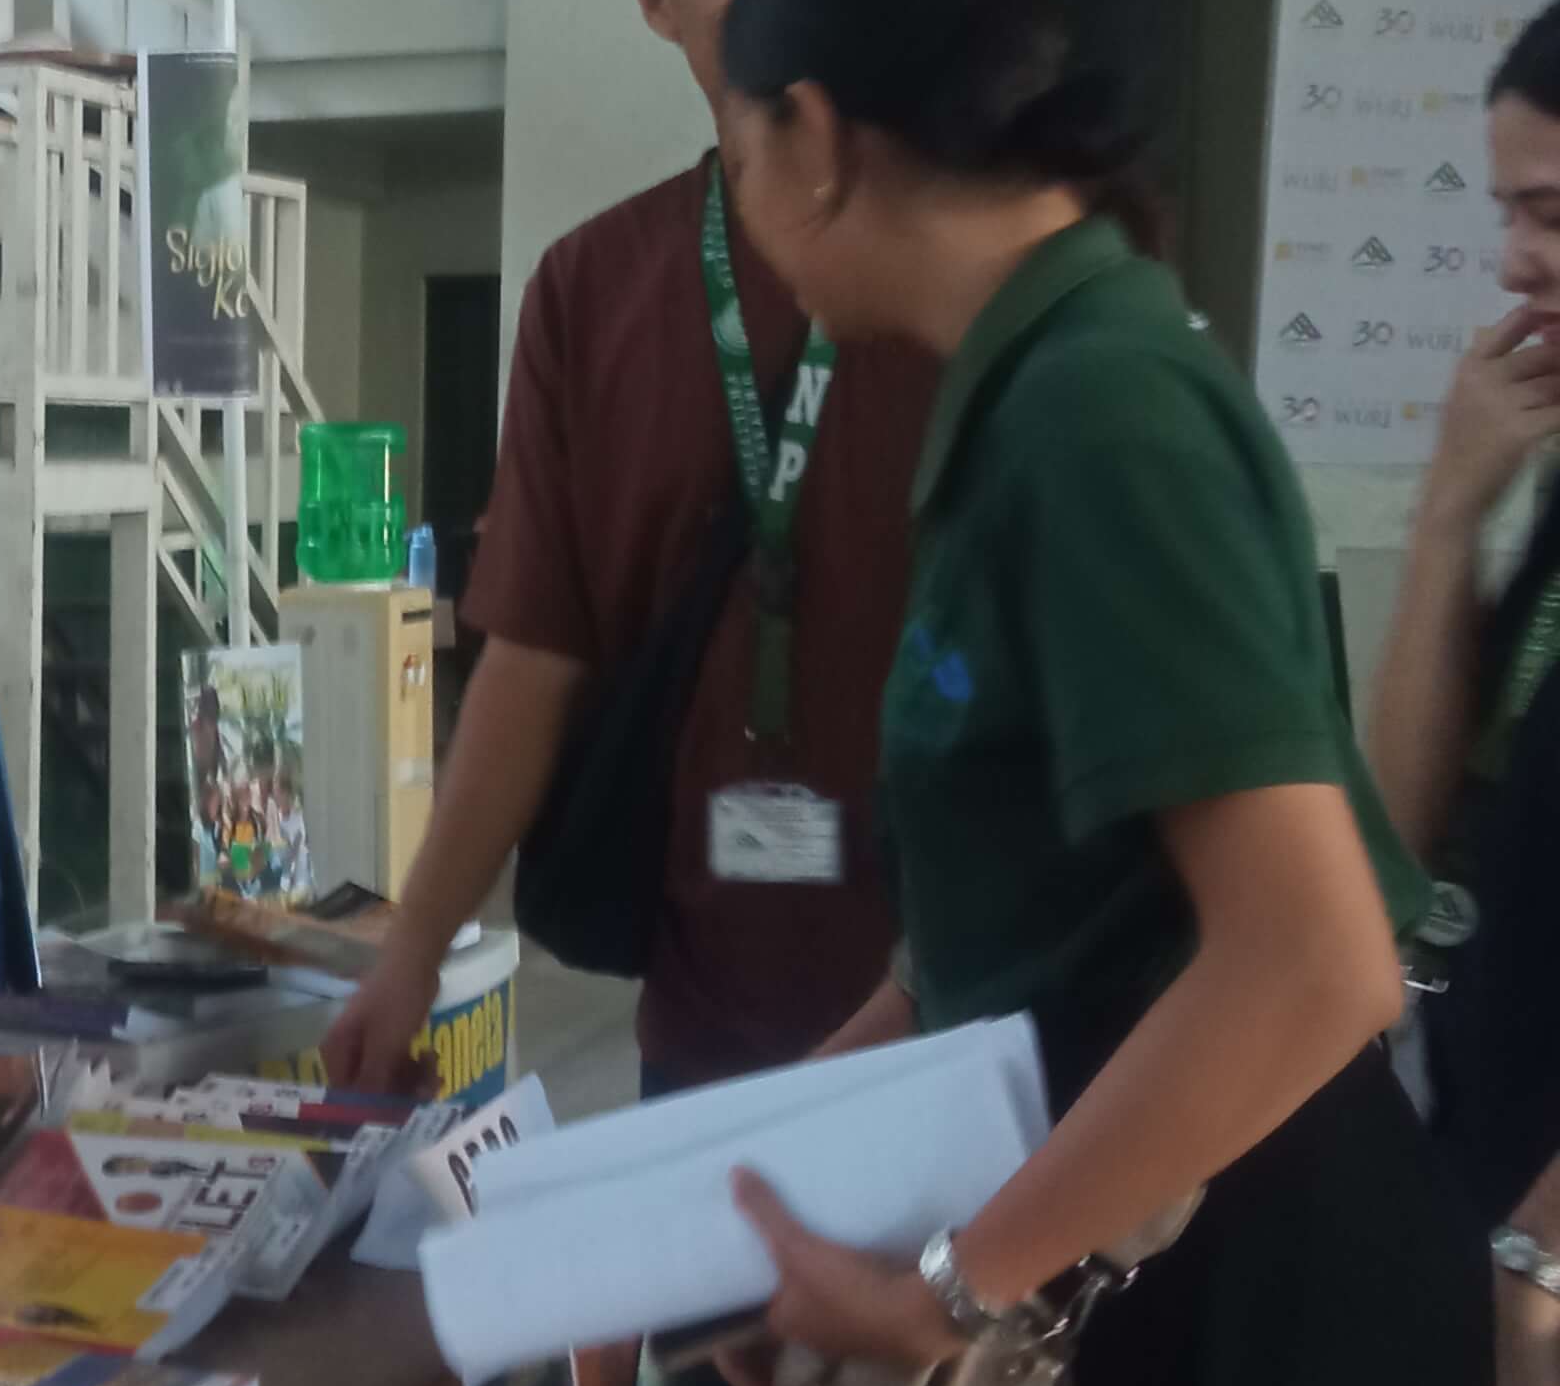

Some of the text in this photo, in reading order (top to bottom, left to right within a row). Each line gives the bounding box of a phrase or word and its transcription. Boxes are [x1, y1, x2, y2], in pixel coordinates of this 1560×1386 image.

[1375, 7, 1416, 37] 30
[1301, 84, 1342, 111] 30
[1423, 246, 1465, 273] 30
[1351, 320, 1393, 347] 30
[1281, 396, 1320, 422] 30
